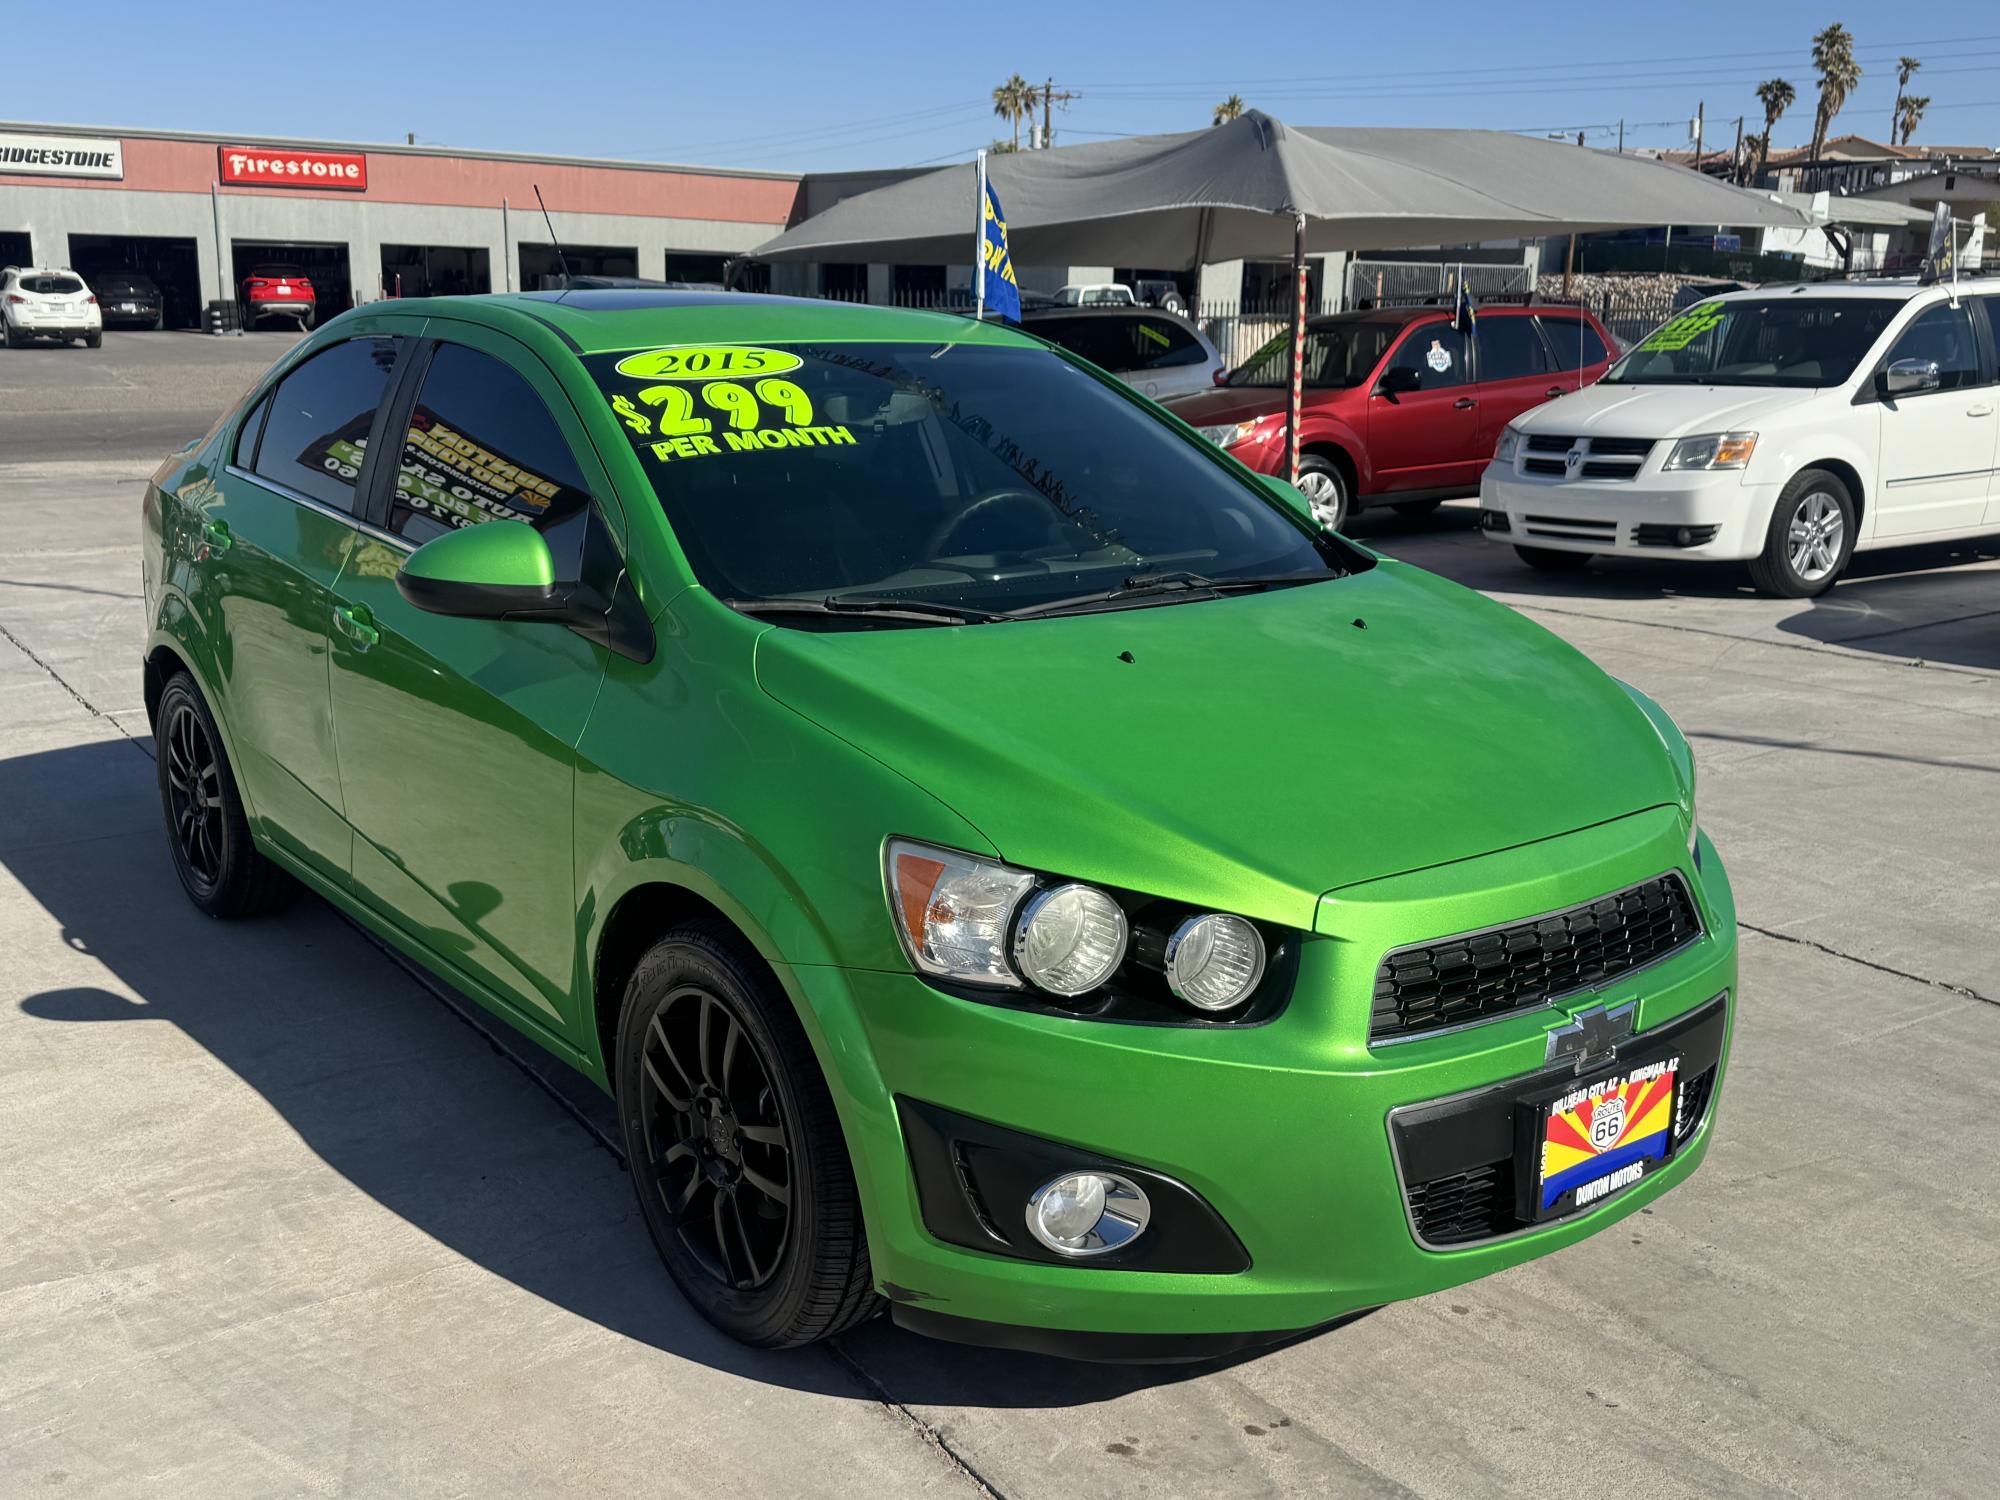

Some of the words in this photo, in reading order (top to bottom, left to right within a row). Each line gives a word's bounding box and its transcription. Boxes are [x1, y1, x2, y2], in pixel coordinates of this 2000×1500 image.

[229, 154, 359, 178] Firestone
[655, 351, 766, 375] 2015
[612, 378, 813, 436] $299
[651, 435, 722, 463] PER
[722, 425, 858, 451] MONTH
[1606, 1076, 1619, 1092] AZ
[1667, 1057, 1680, 1072] AZ
[1597, 1103, 1621, 1118] ROUTE
[1595, 1116, 1619, 1142] 66
[1576, 1175, 1610, 1206] DUNTON
[1610, 1160, 1644, 1192] MOTORS
